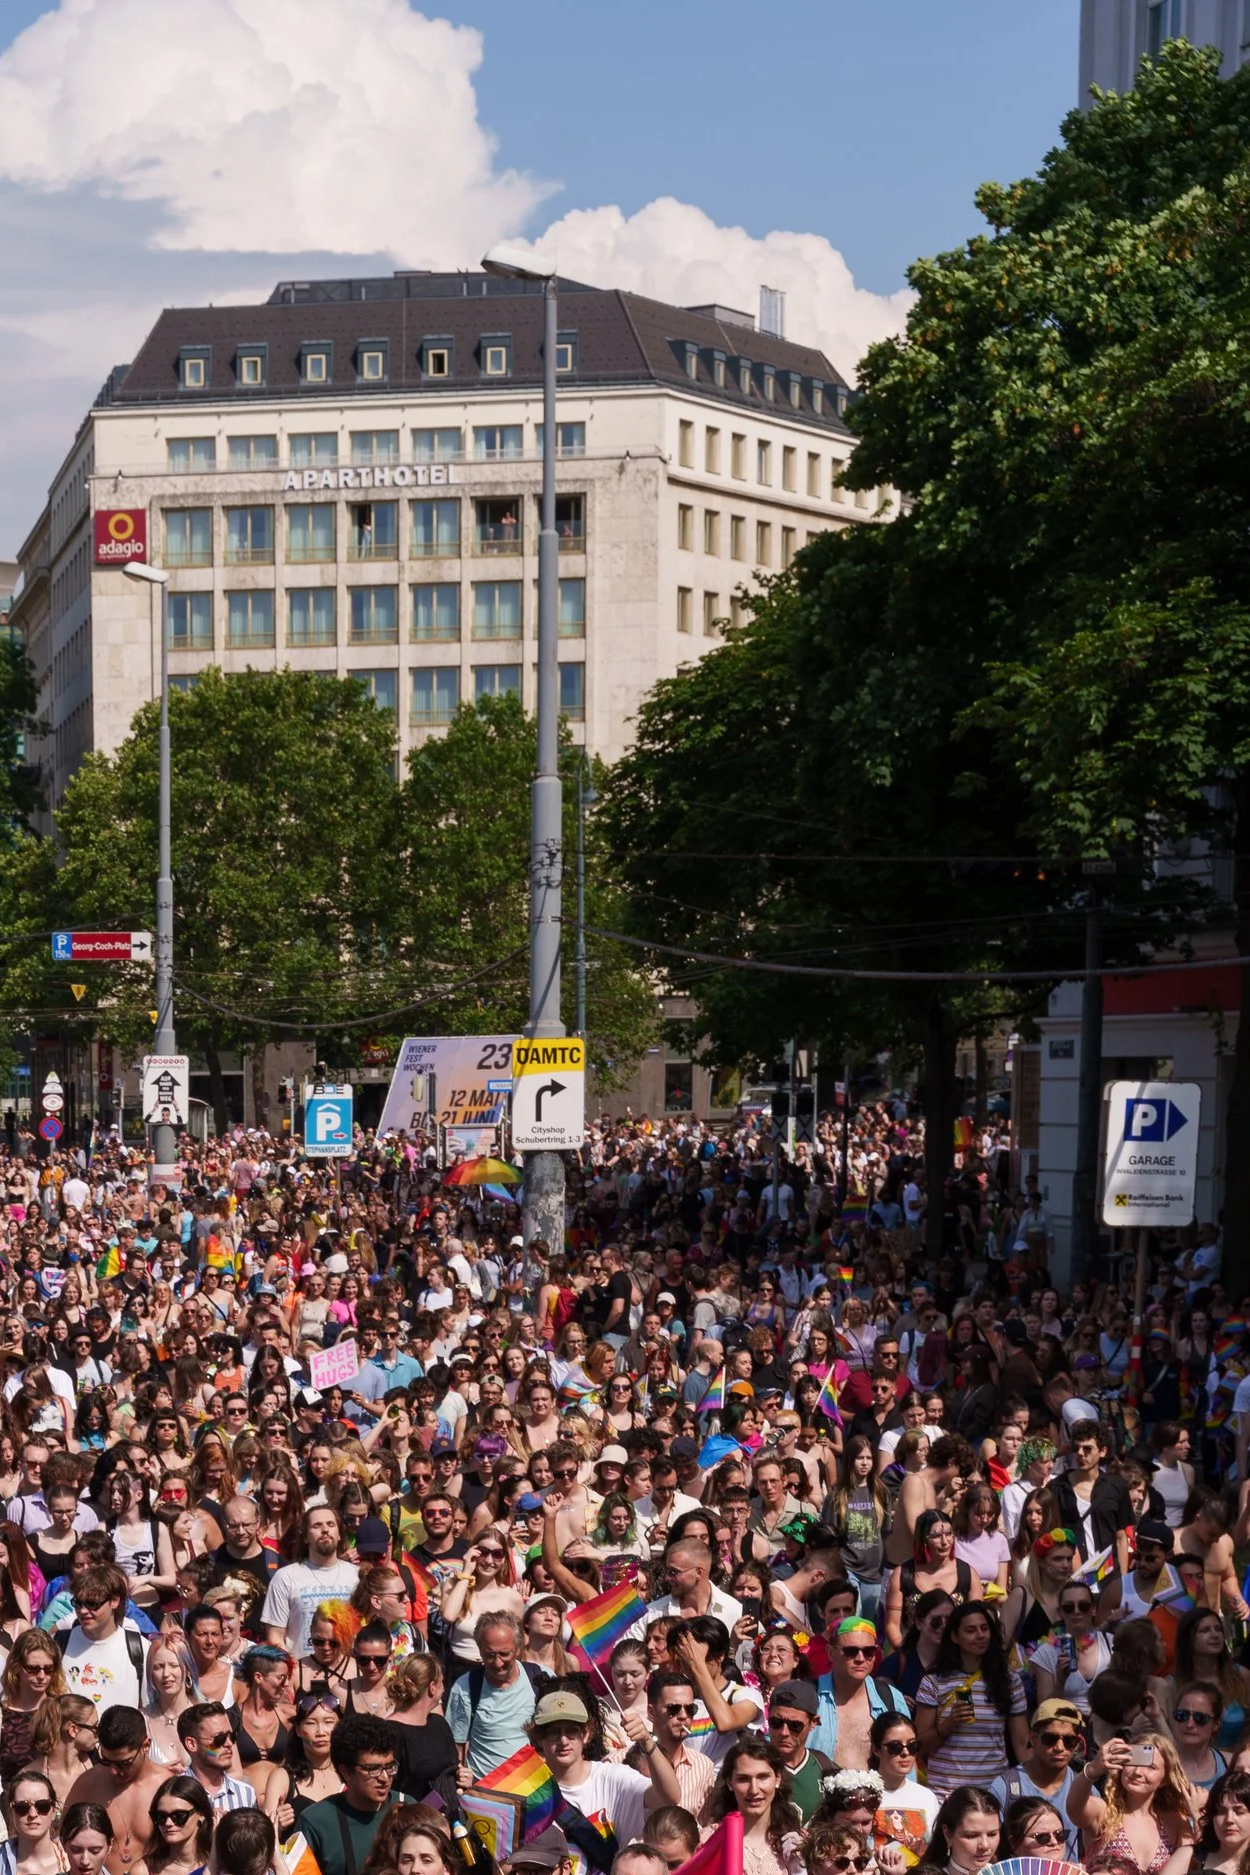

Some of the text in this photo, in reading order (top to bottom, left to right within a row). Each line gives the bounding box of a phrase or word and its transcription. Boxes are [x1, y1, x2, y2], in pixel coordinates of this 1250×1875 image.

[284, 465, 461, 490] APARTHOTEL
[98, 539, 144, 558] adagio
[408, 1044, 437, 1053] WIENER
[405, 1054, 423, 1062] FEST
[403, 1063, 435, 1072] WOCHEN
[449, 1090, 501, 1107] 12 MAI
[531, 1126, 565, 1135] Cityshop
[515, 1136, 566, 1144] Schubertring
[1128, 1156, 1176, 1166] GARAGE
[312, 1342, 355, 1370] FREE
[314, 1360, 355, 1390] HUGS
